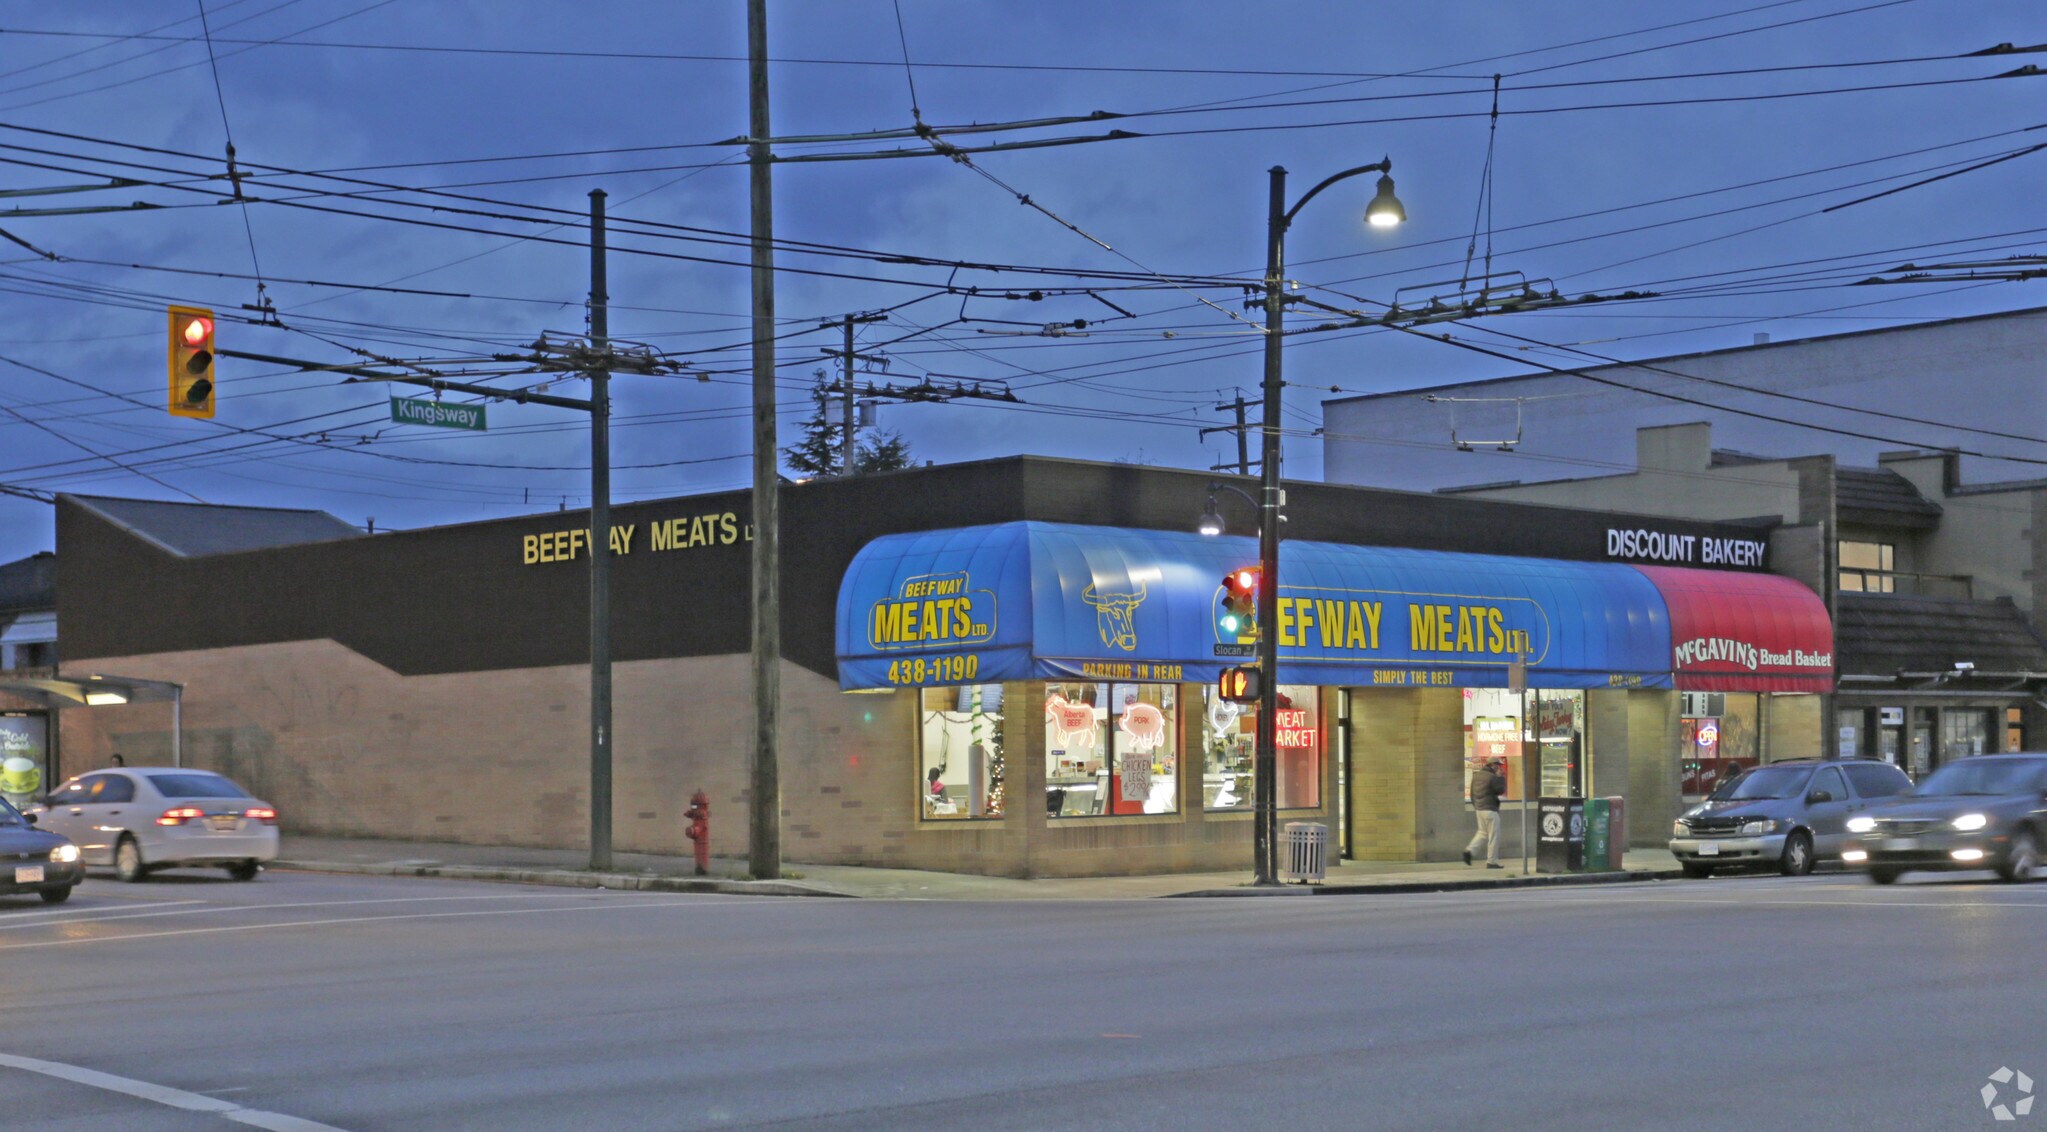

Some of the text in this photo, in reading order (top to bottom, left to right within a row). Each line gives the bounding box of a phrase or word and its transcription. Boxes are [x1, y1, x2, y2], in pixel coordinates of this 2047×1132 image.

[397, 399, 478, 427] Kingsway
[523, 524, 634, 564] BEEFAY
[651, 512, 738, 551] MEATS
[1607, 529, 1766, 567] DISCOUNT BAKERY
[905, 578, 964, 598] BEEFWAY
[874, 597, 972, 644] MEATS
[1409, 604, 1504, 654] MEATS
[1215, 645, 1242, 656] Slocan
[1760, 650, 1793, 666] Bread
[1795, 650, 1833, 667] Basket
[888, 654, 978, 684] 438-1190
[1083, 663, 1182, 680] PARKING IN REAR
[1373, 670, 1453, 685] SIMPLY THE BEST
[1275, 730, 1316, 747] ARKET
[1698, 730, 1717, 742] OPEN
[1121, 759, 1152, 772] CHICKEN
